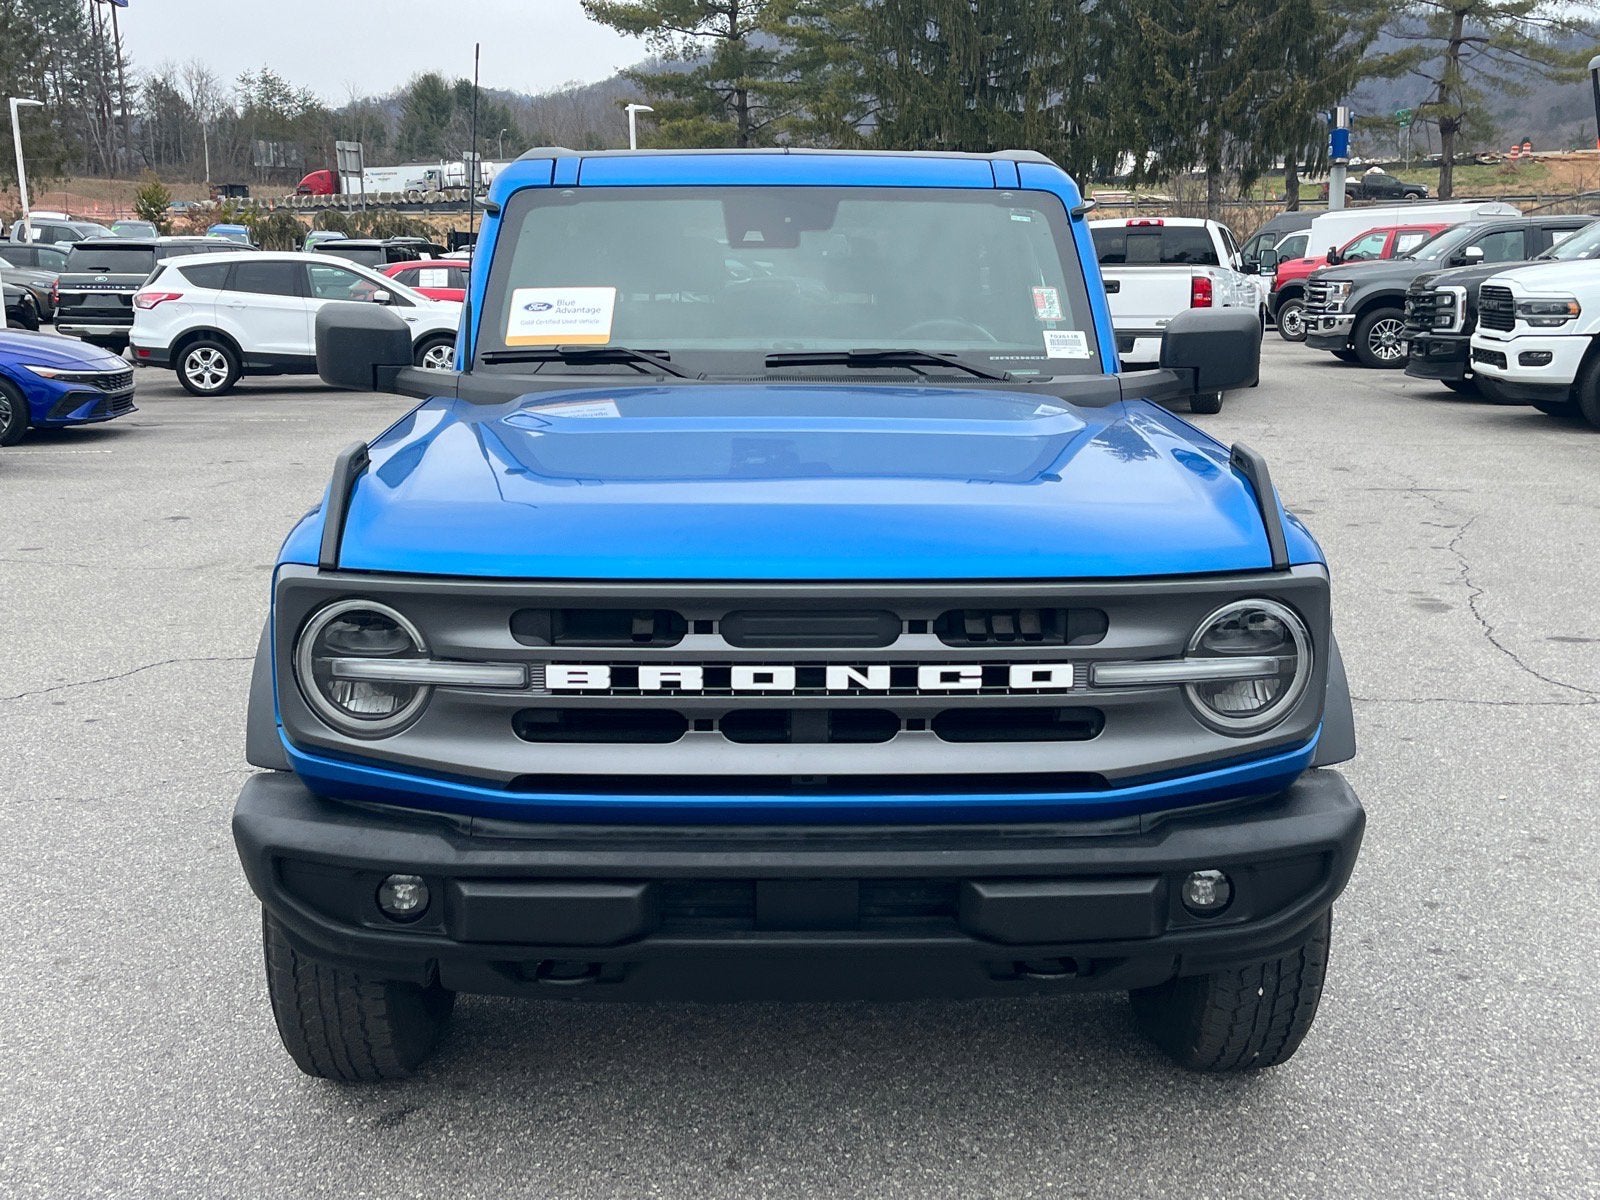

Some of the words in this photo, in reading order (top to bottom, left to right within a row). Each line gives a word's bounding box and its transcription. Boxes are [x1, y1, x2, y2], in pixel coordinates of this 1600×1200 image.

[525, 302, 552, 312] Ford
[556, 299, 576, 307] Blue
[555, 307, 602, 316] Advantage
[545, 664, 1073, 690] BRONCO
